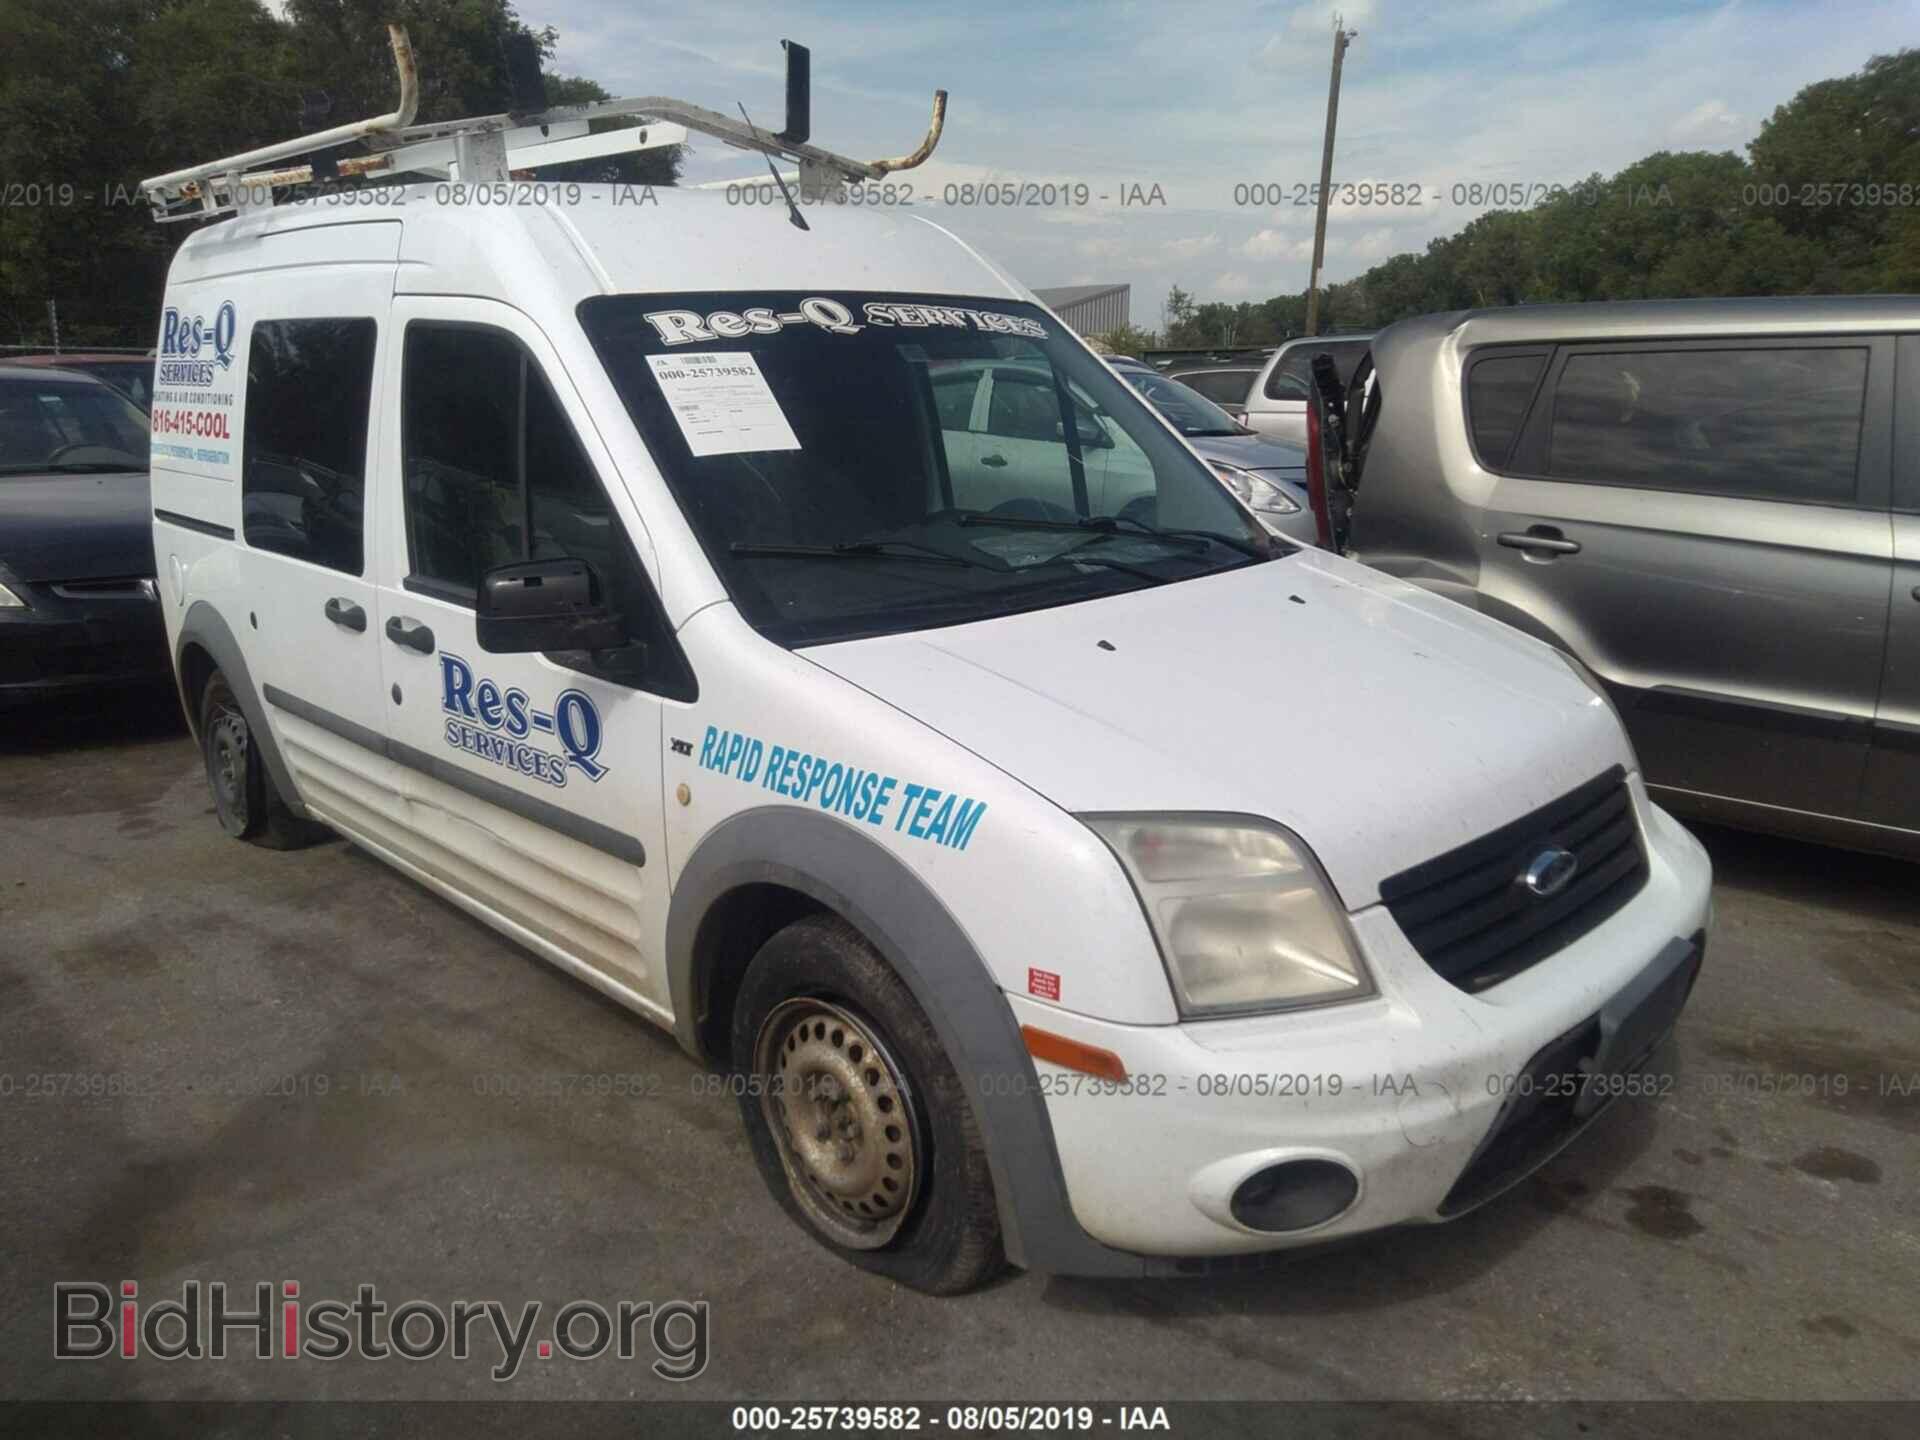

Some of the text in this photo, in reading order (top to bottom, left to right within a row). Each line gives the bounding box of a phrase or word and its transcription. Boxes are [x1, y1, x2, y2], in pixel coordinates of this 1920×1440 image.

[161, 300, 236, 371] Res-Q
[643, 297, 1048, 346] Res-Q SERVICES
[159, 361, 215, 386] SERVICES
[658, 366, 756, 381] 000-25739582
[153, 409, 230, 440] 816-415-COOL
[439, 652, 609, 782] Res-Q
[446, 719, 567, 788] SERVICES
[700, 726, 986, 850] RAPID RESPONSE TEAM
